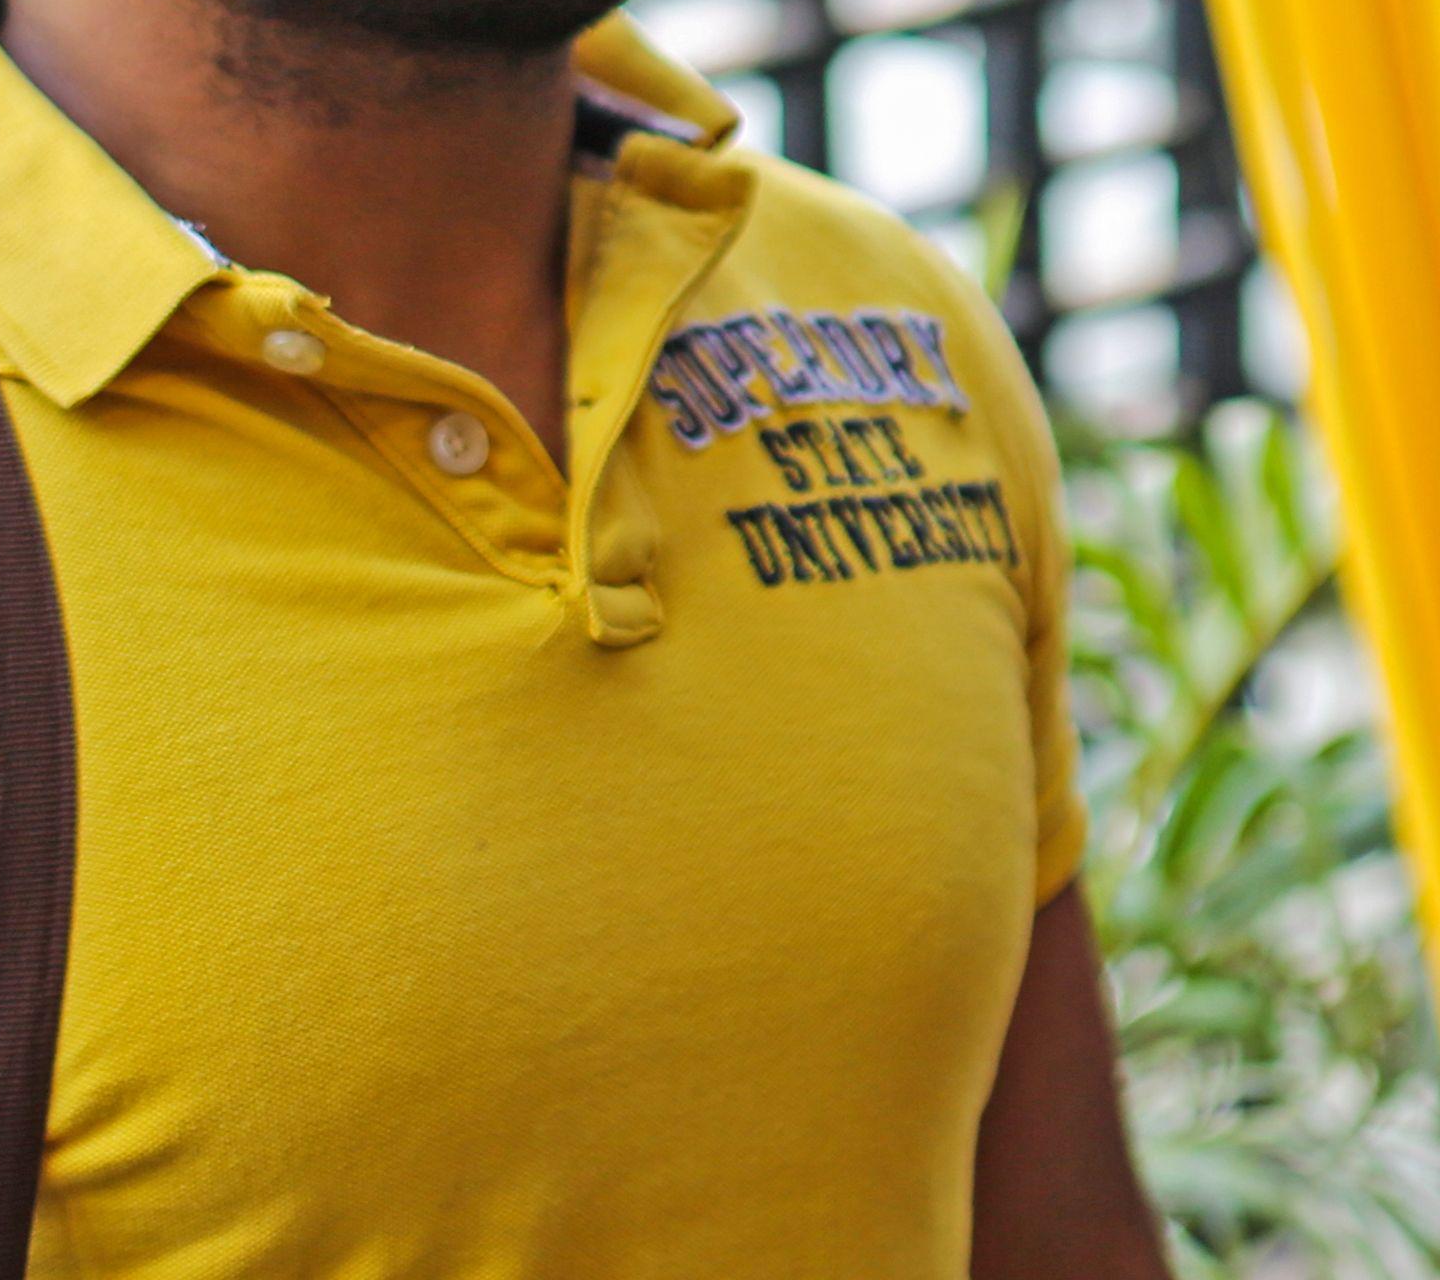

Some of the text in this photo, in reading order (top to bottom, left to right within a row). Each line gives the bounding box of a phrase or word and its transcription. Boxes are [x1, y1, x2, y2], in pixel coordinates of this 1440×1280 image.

[652, 306, 971, 450] SUPERDRY
[760, 416, 923, 492] STATE
[726, 480, 1020, 586] UNIVERSITY
